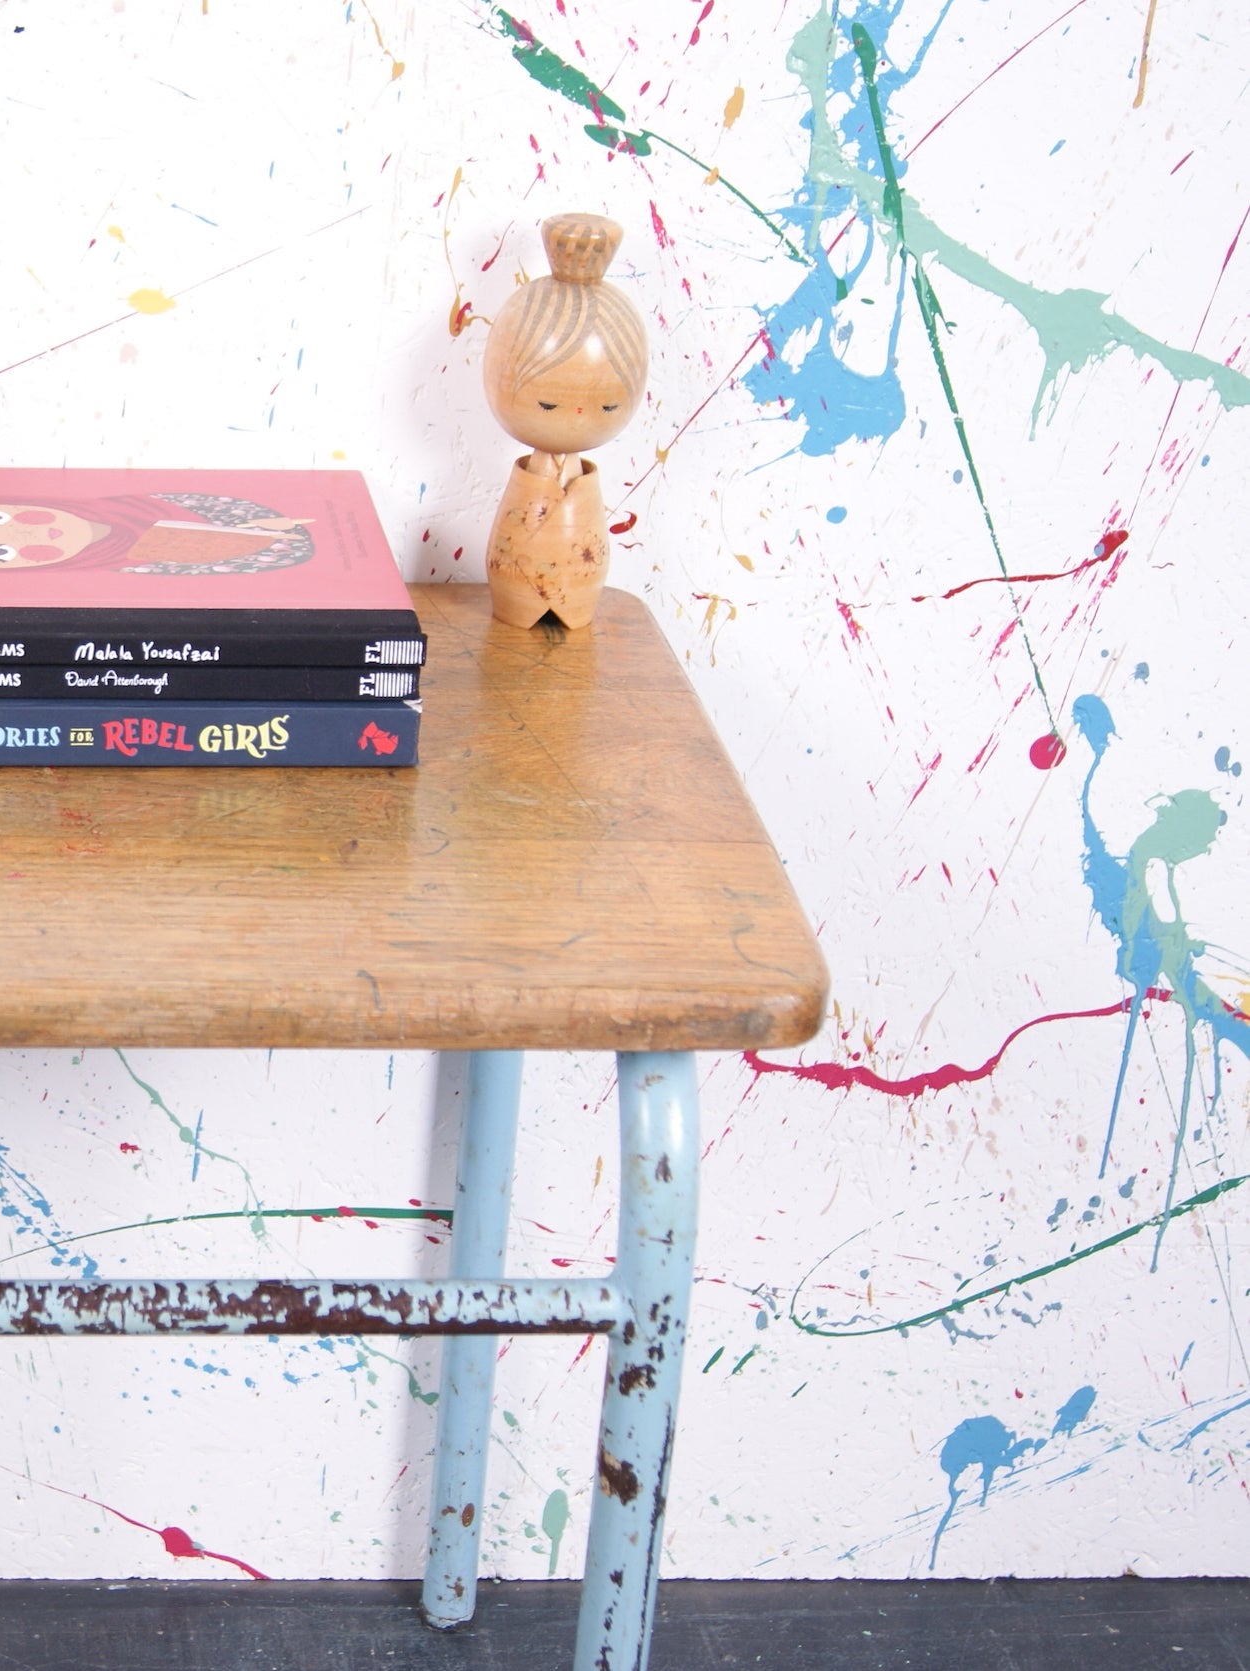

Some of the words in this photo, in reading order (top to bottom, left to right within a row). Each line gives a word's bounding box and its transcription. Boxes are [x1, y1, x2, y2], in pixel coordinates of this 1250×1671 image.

[74, 642, 133, 661] Malala
[142, 641, 220, 661] Yousafzai
[65, 671, 99, 687] David
[70, 732, 93, 743] FOR
[101, 718, 194, 756] REBEL
